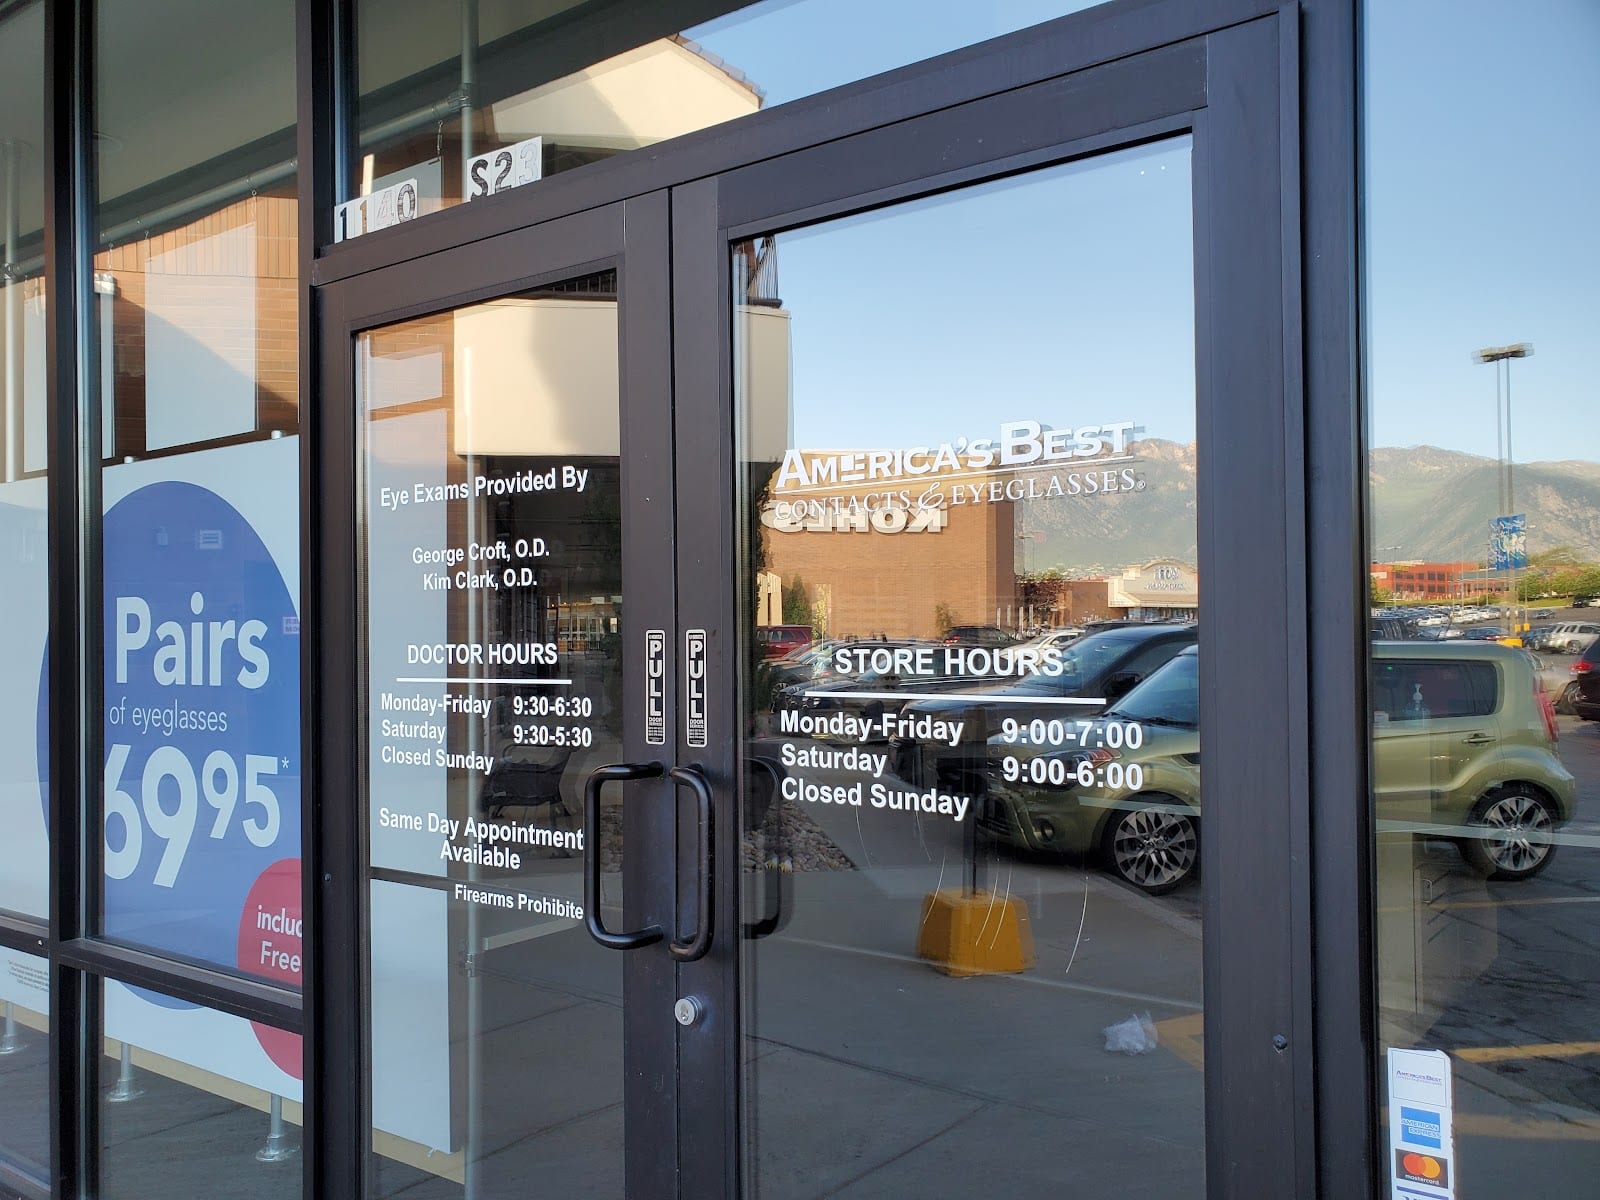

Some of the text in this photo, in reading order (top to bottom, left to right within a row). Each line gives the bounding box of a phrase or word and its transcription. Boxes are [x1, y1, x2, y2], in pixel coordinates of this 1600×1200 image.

[775, 420, 1135, 489] AMERICA'S BEST
[380, 465, 589, 511] Eye Exams Provided By
[774, 488, 912, 522] CONTACTS
[917, 481, 945, 514] &
[412, 538, 550, 567] George Croft, O.D.
[423, 567, 538, 591] Kim Clark, O.D.
[116, 592, 270, 689] Pairs
[407, 642, 558, 665] DOCTOR HOURS
[650, 641, 663, 717] PULL
[690, 640, 703, 719] PULL
[835, 648, 1064, 677] STORE HOURS
[109, 697, 228, 736] of eyeglasses
[380, 692, 592, 719] Monday-Friday 9:30-6:30
[380, 719, 592, 748] Saturday 9:30-5:30
[780, 709, 1143, 750] Monday-Friday 9:00-7:00
[381, 745, 494, 775] Closed Sunday
[781, 743, 1144, 790] Saturday 9:00-6:00
[781, 776, 970, 821] Closed Sunday
[379, 807, 584, 851] Same Day Appointment
[440, 839, 521, 870] Available
[454, 883, 584, 920] Firearms Prohibite
[260, 941, 301, 973] Free
[1401, 1118, 1440, 1131] AMERICAN
[1409, 1127, 1442, 1138] EXPRESS
